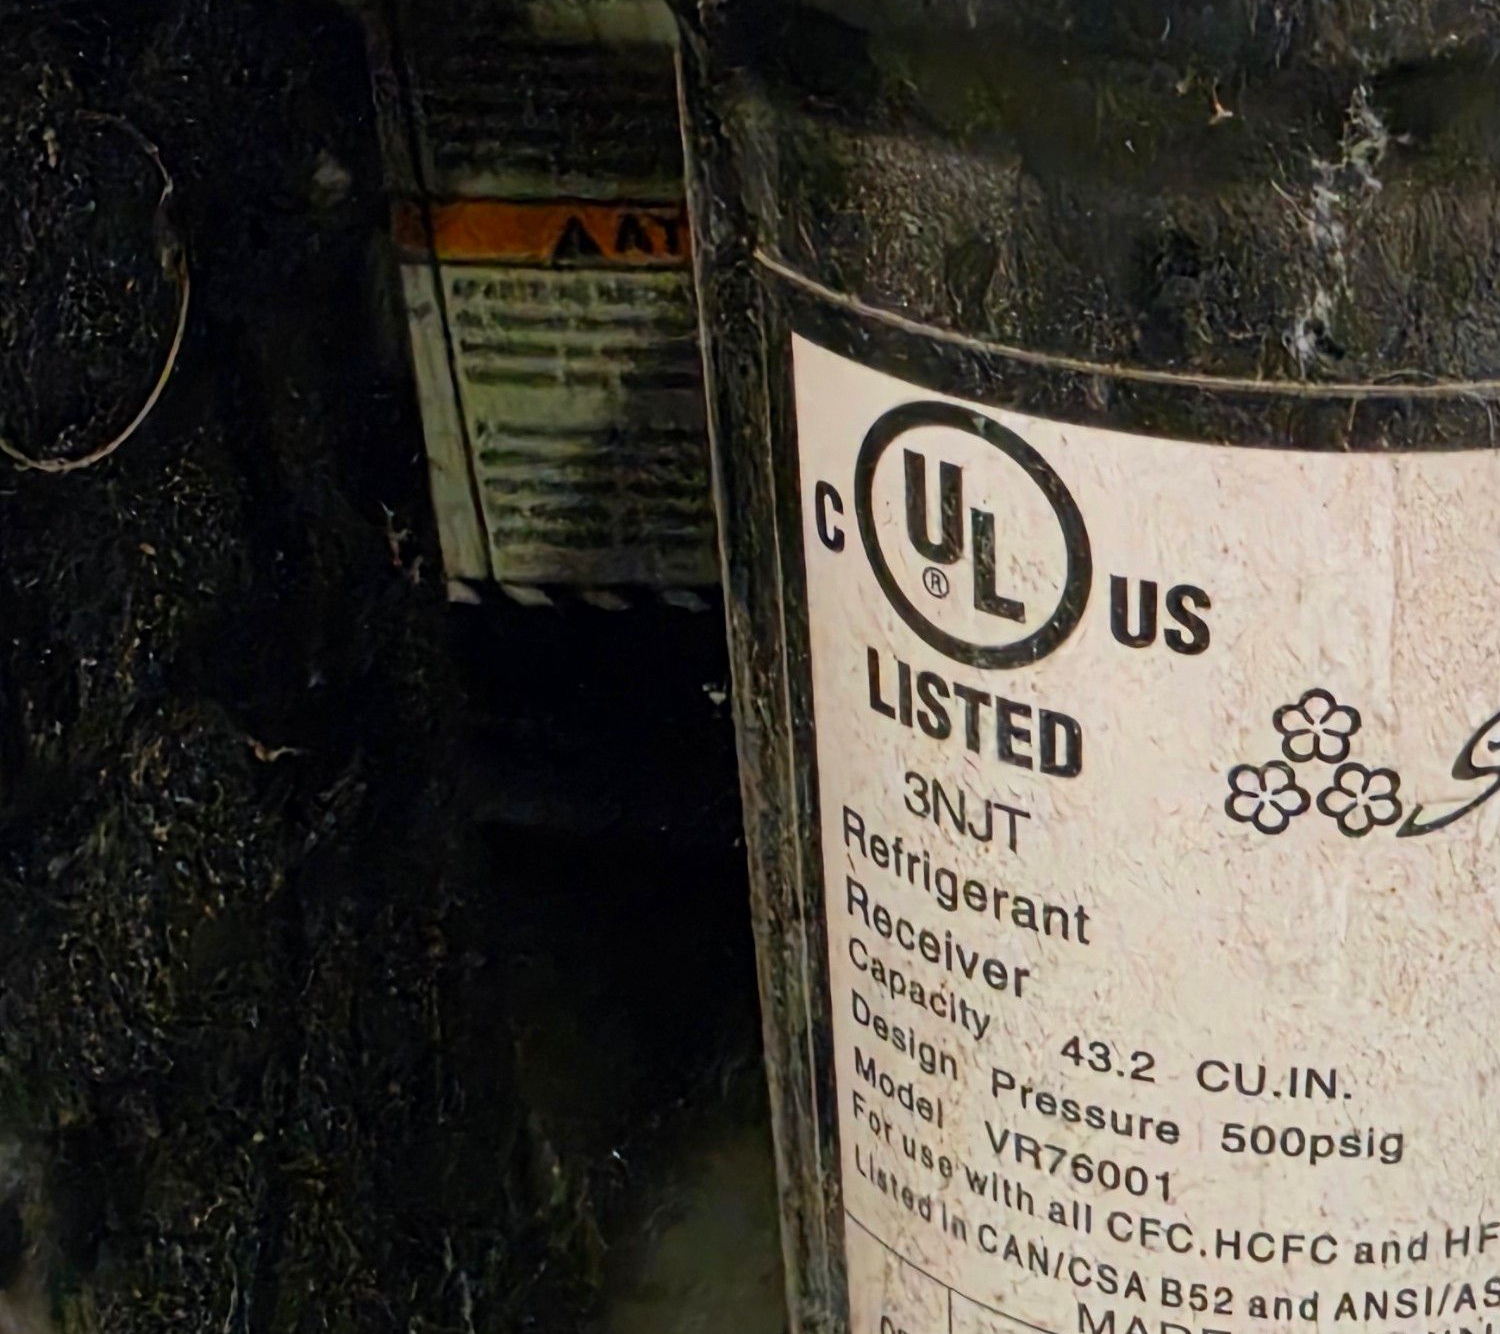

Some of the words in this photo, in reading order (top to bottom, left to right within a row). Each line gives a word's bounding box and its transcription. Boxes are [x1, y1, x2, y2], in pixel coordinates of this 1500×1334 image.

[815, 480, 845, 553] C
[904, 448, 1025, 624] UL
[1110, 574, 1212, 656] US
[867, 648, 1083, 778] LISTED
[843, 805, 1090, 945] Refrigerant
[904, 771, 1031, 854] 3NJT
[846, 875, 1030, 998] Receiver
[849, 938, 990, 1041] Capacity
[1061, 1036, 1156, 1083] 43.2
[852, 989, 958, 1080] Design
[992, 1068, 1180, 1145] Pressure
[1221, 1123, 1404, 1166] 500psig
[854, 1046, 944, 1129] Model
[985, 1120, 1172, 1203] VR76001
[852, 1090, 892, 1144] For
[903, 1134, 952, 1178] use
[966, 1164, 1034, 1216] with
[1048, 1200, 1092, 1234] all
[1354, 1231, 1428, 1265] and
[856, 1144, 932, 1223] Listed
[942, 1202, 967, 1244] in
[978, 1224, 1146, 1302] CAN/CSA
[1161, 1277, 1234, 1315] B52
[1248, 1291, 1318, 1321] and
